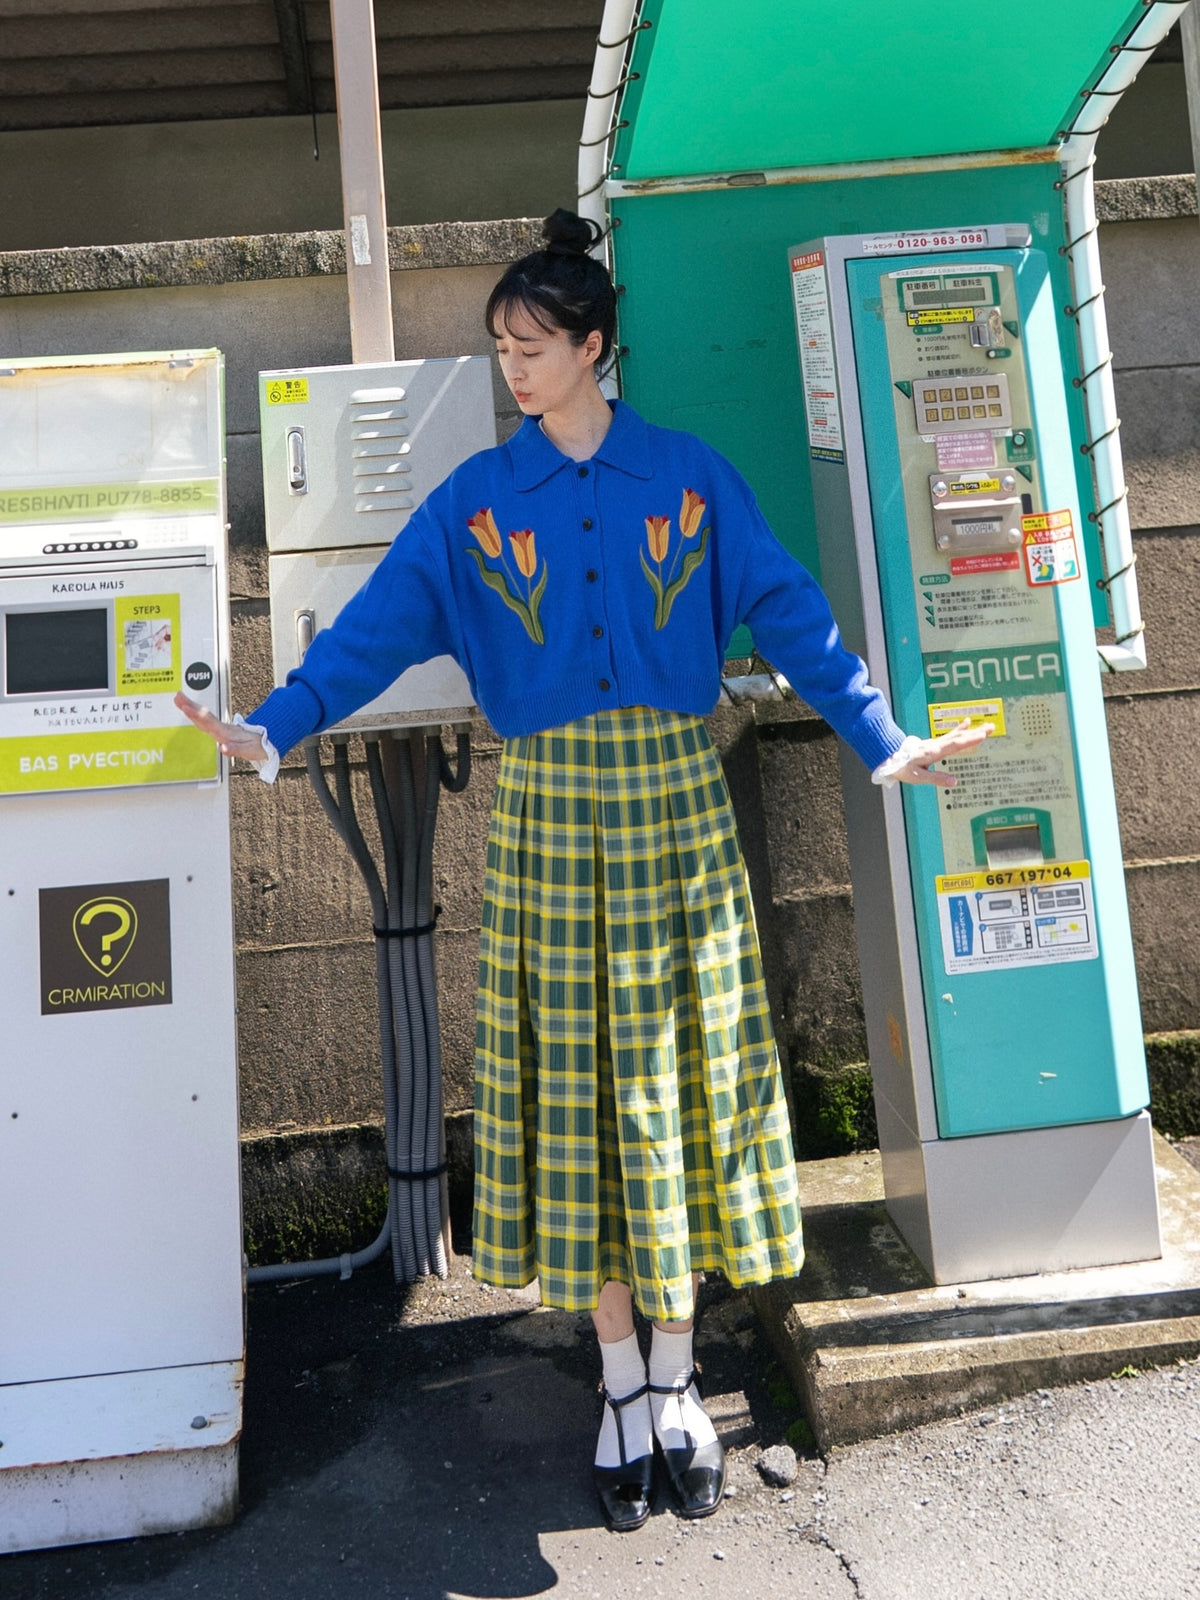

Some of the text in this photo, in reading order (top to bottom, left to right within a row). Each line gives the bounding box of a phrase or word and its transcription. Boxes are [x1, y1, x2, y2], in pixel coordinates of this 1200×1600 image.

[898, 234, 983, 248] 0120-963-098
[960, 523, 997, 534] 1000円札
[133, 605, 161, 615] STEP3
[187, 672, 211, 681] PUSH
[927, 653, 1061, 689] SANICA
[68, 749, 164, 771] PVECTION
[986, 872, 1013, 886] 667
[48, 981, 165, 1005] CRMIRATION
